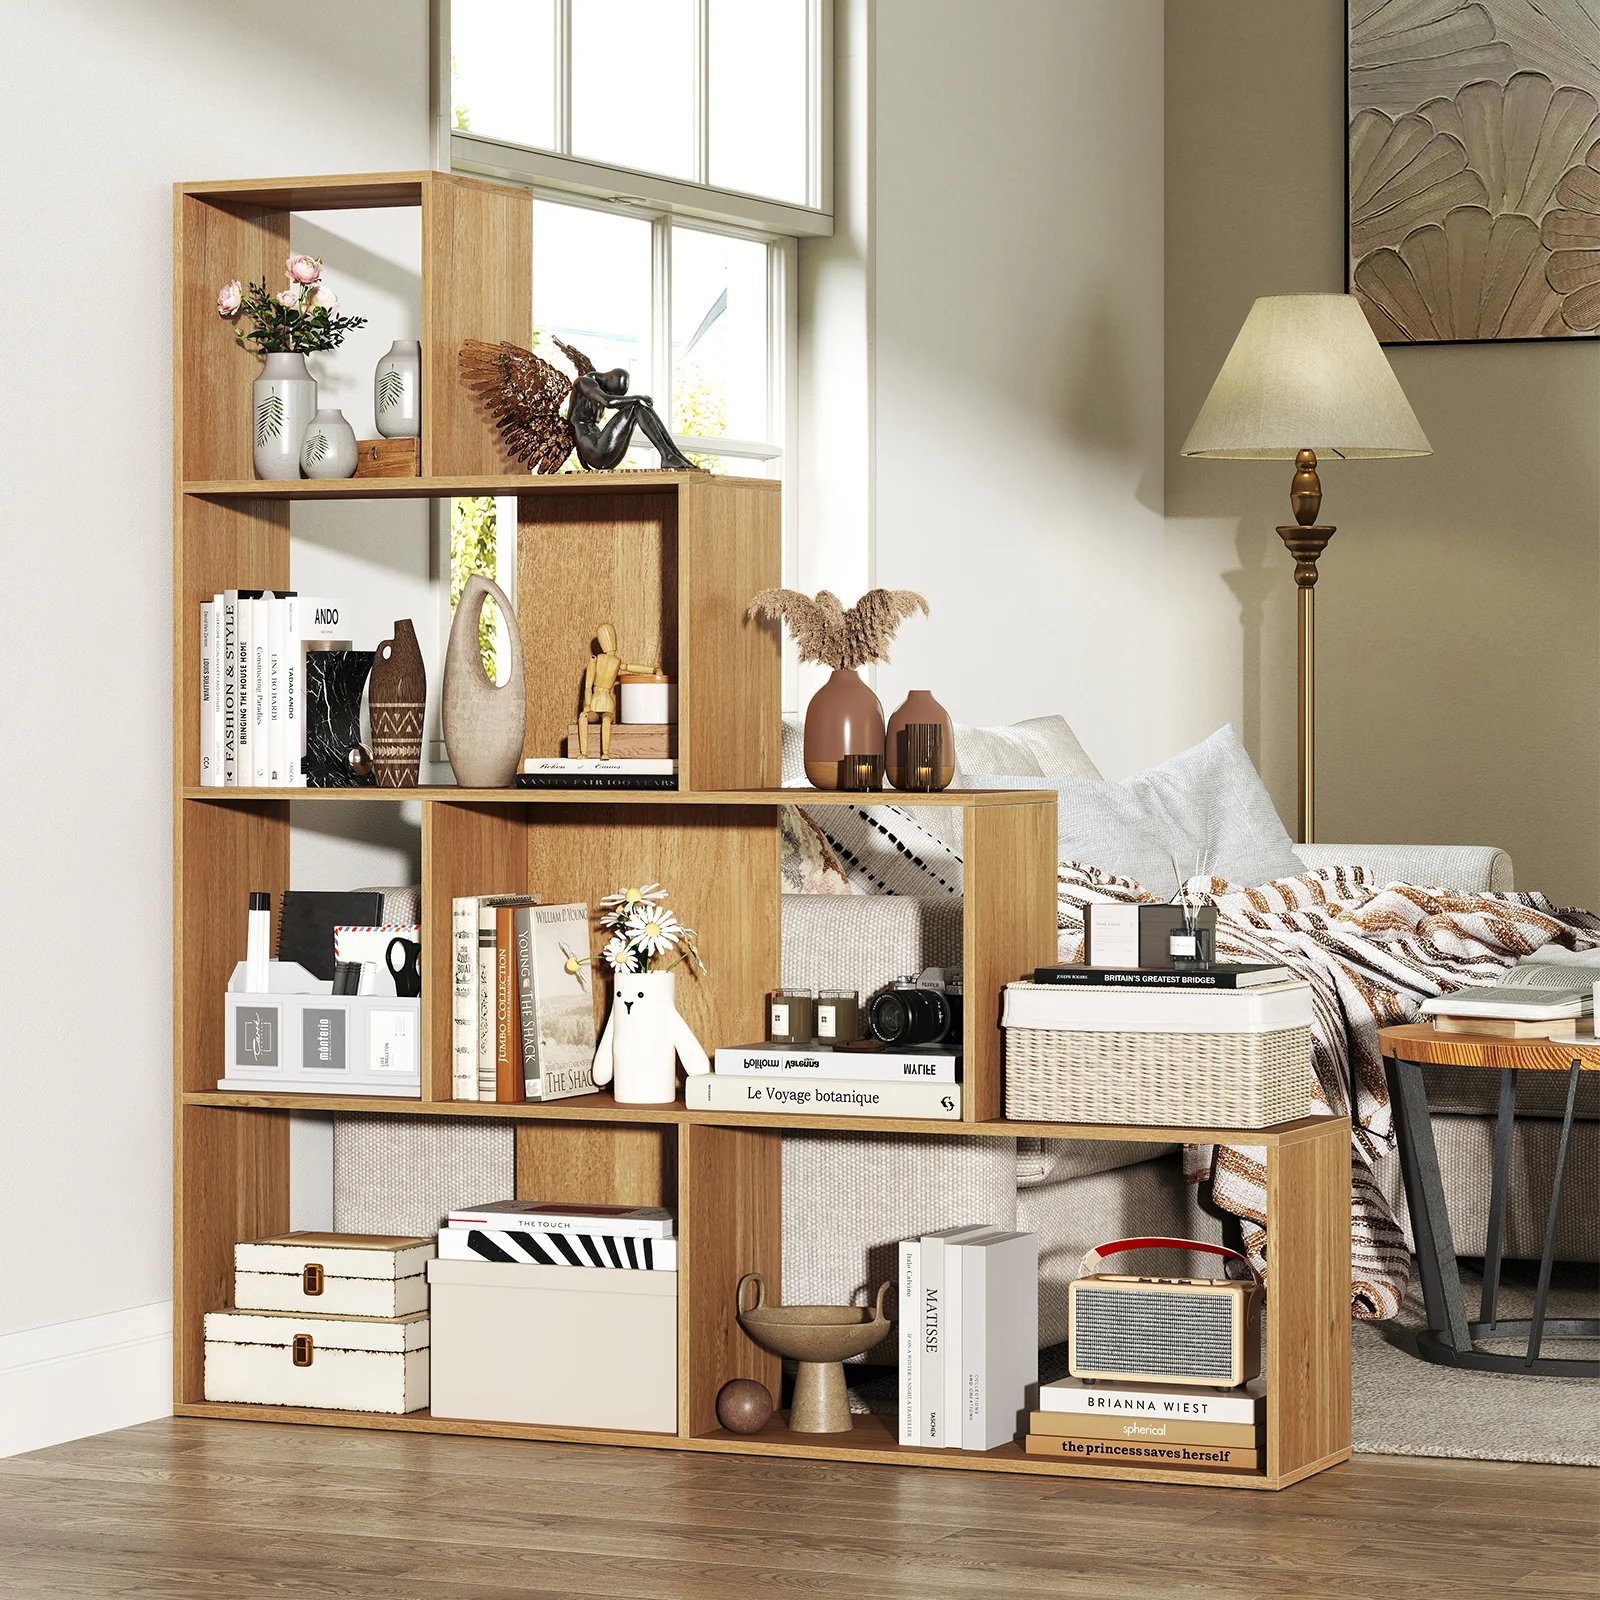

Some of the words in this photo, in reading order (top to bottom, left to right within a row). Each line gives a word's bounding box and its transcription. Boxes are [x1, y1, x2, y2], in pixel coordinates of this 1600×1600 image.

[315, 609, 338, 625] ANDO
[226, 605, 235, 660] STYLE
[226, 665, 235, 677] &
[271, 678, 277, 691] BO
[226, 684, 235, 761] FASHION
[535, 911, 561, 923] WILLIAM
[519, 931, 530, 977] YOUNG
[498, 948, 507, 1020] COLLECTION
[1104, 974, 1140, 983] BRITAIN'S
[1142, 975, 1180, 984] GREATEST
[1182, 976, 1215, 985] BRIDGES
[521, 990, 533, 1017] THE
[498, 1024, 509, 1063] JUMBO
[523, 1020, 536, 1064] SHACK
[546, 1072, 566, 1092] THE
[568, 1069, 593, 1090] SHAC
[748, 1087, 762, 1100] Le
[766, 1087, 811, 1104] Voyage
[815, 1088, 880, 1106] botanique
[537, 1221, 571, 1229] TOUCH
[926, 1289, 938, 1353] MATISSE
[1088, 1397, 1156, 1411] BRIANNA
[1164, 1402, 1208, 1414] WIEST
[1123, 1422, 1166, 1436] spherical
[1062, 1441, 1084, 1452] the
[1086, 1444, 1143, 1456] princess
[1144, 1449, 1181, 1459] saves
[1182, 1449, 1230, 1462] herself
